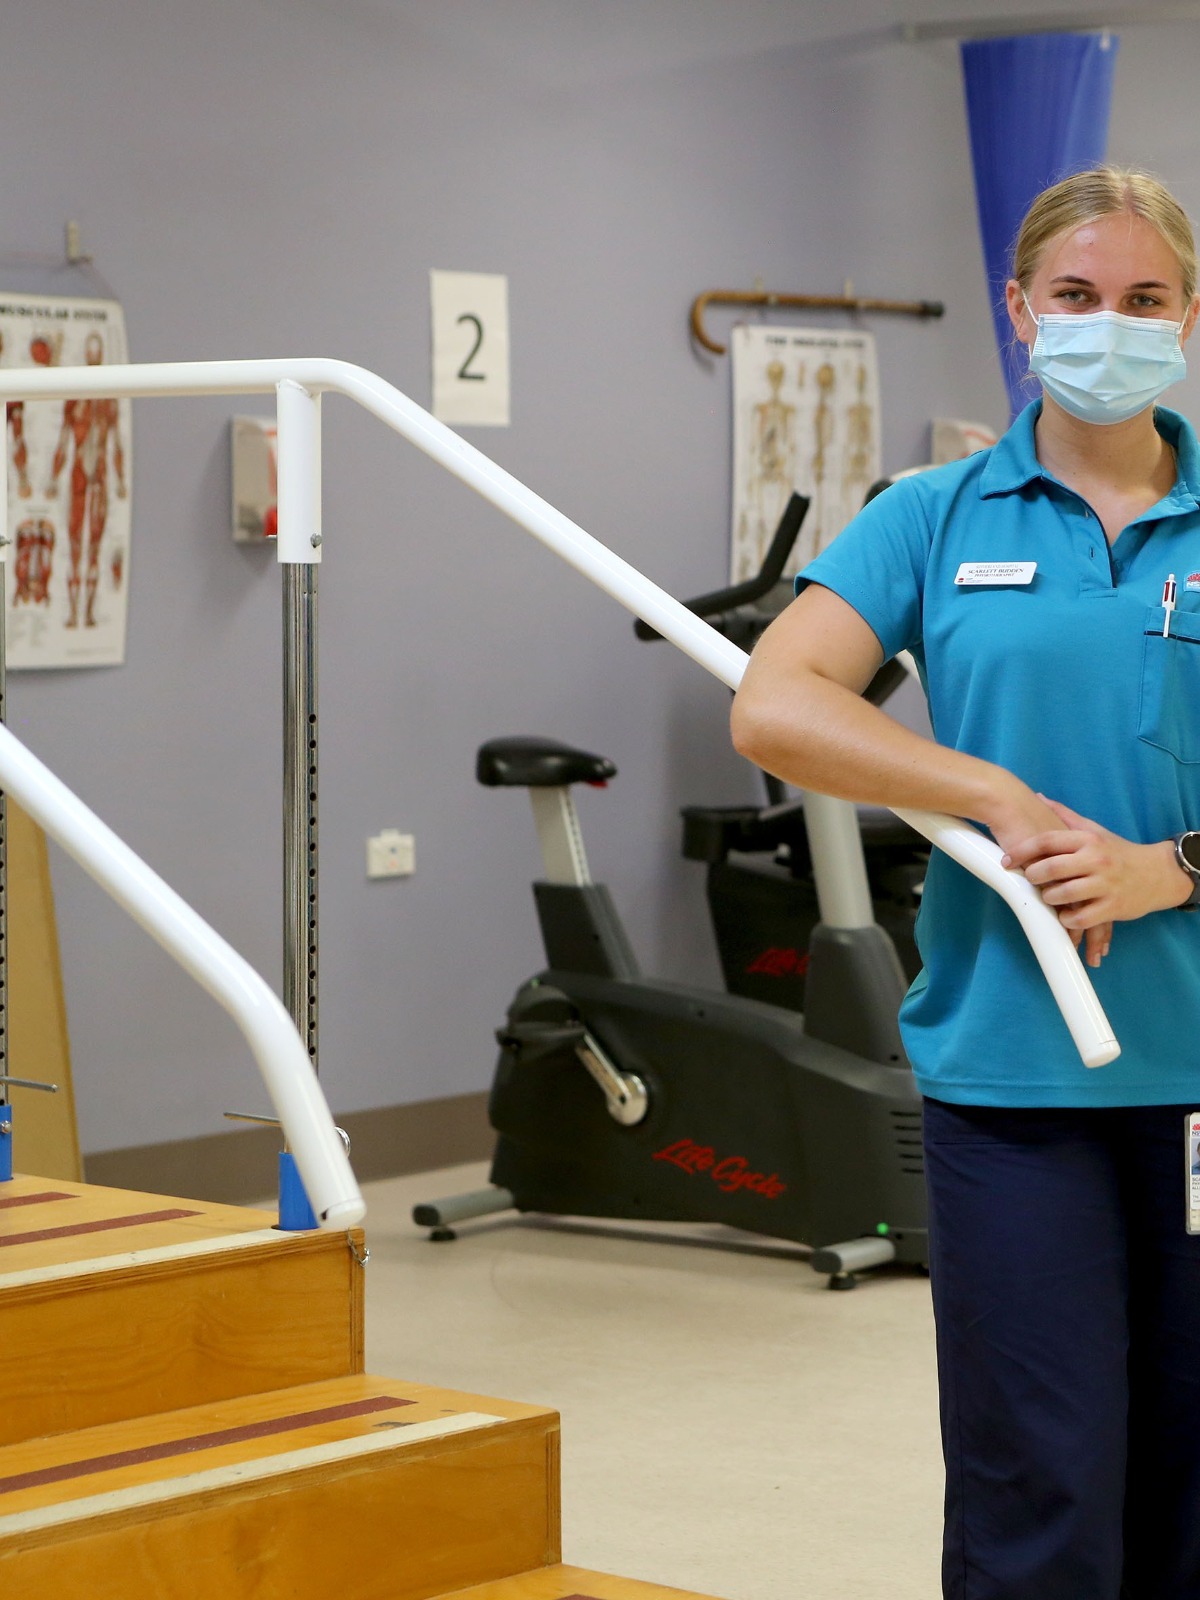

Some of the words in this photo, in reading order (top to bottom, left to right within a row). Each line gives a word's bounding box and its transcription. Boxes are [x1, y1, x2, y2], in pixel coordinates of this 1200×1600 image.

[457, 313, 486, 381] 2
[652, 1138, 715, 1174] Life
[711, 1155, 787, 1199] Cycle
